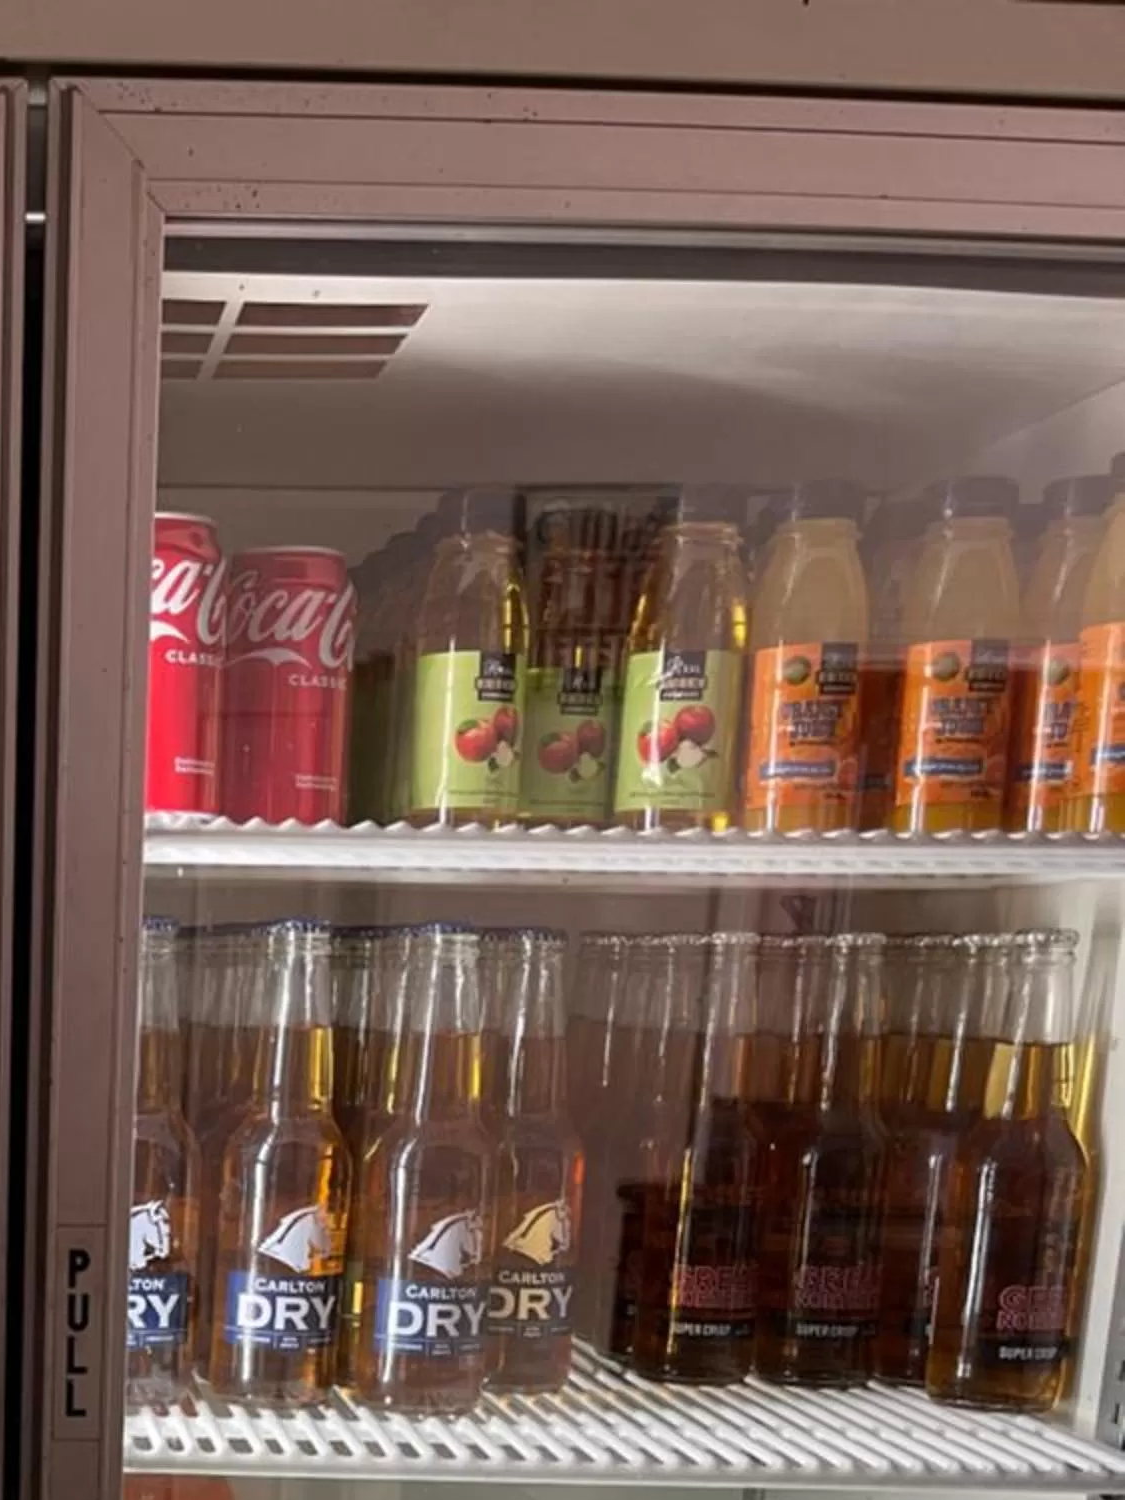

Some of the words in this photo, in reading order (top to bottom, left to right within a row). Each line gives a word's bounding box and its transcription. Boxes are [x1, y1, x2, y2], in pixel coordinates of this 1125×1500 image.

[255, 1278, 326, 1294] CARLTON
[499, 1270, 566, 1285] CARLTON
[405, 1284, 477, 1300] CARLTON
[236, 1292, 336, 1331] DRY
[387, 1300, 486, 1338] DRY
[65, 1249, 92, 1417] PULL
